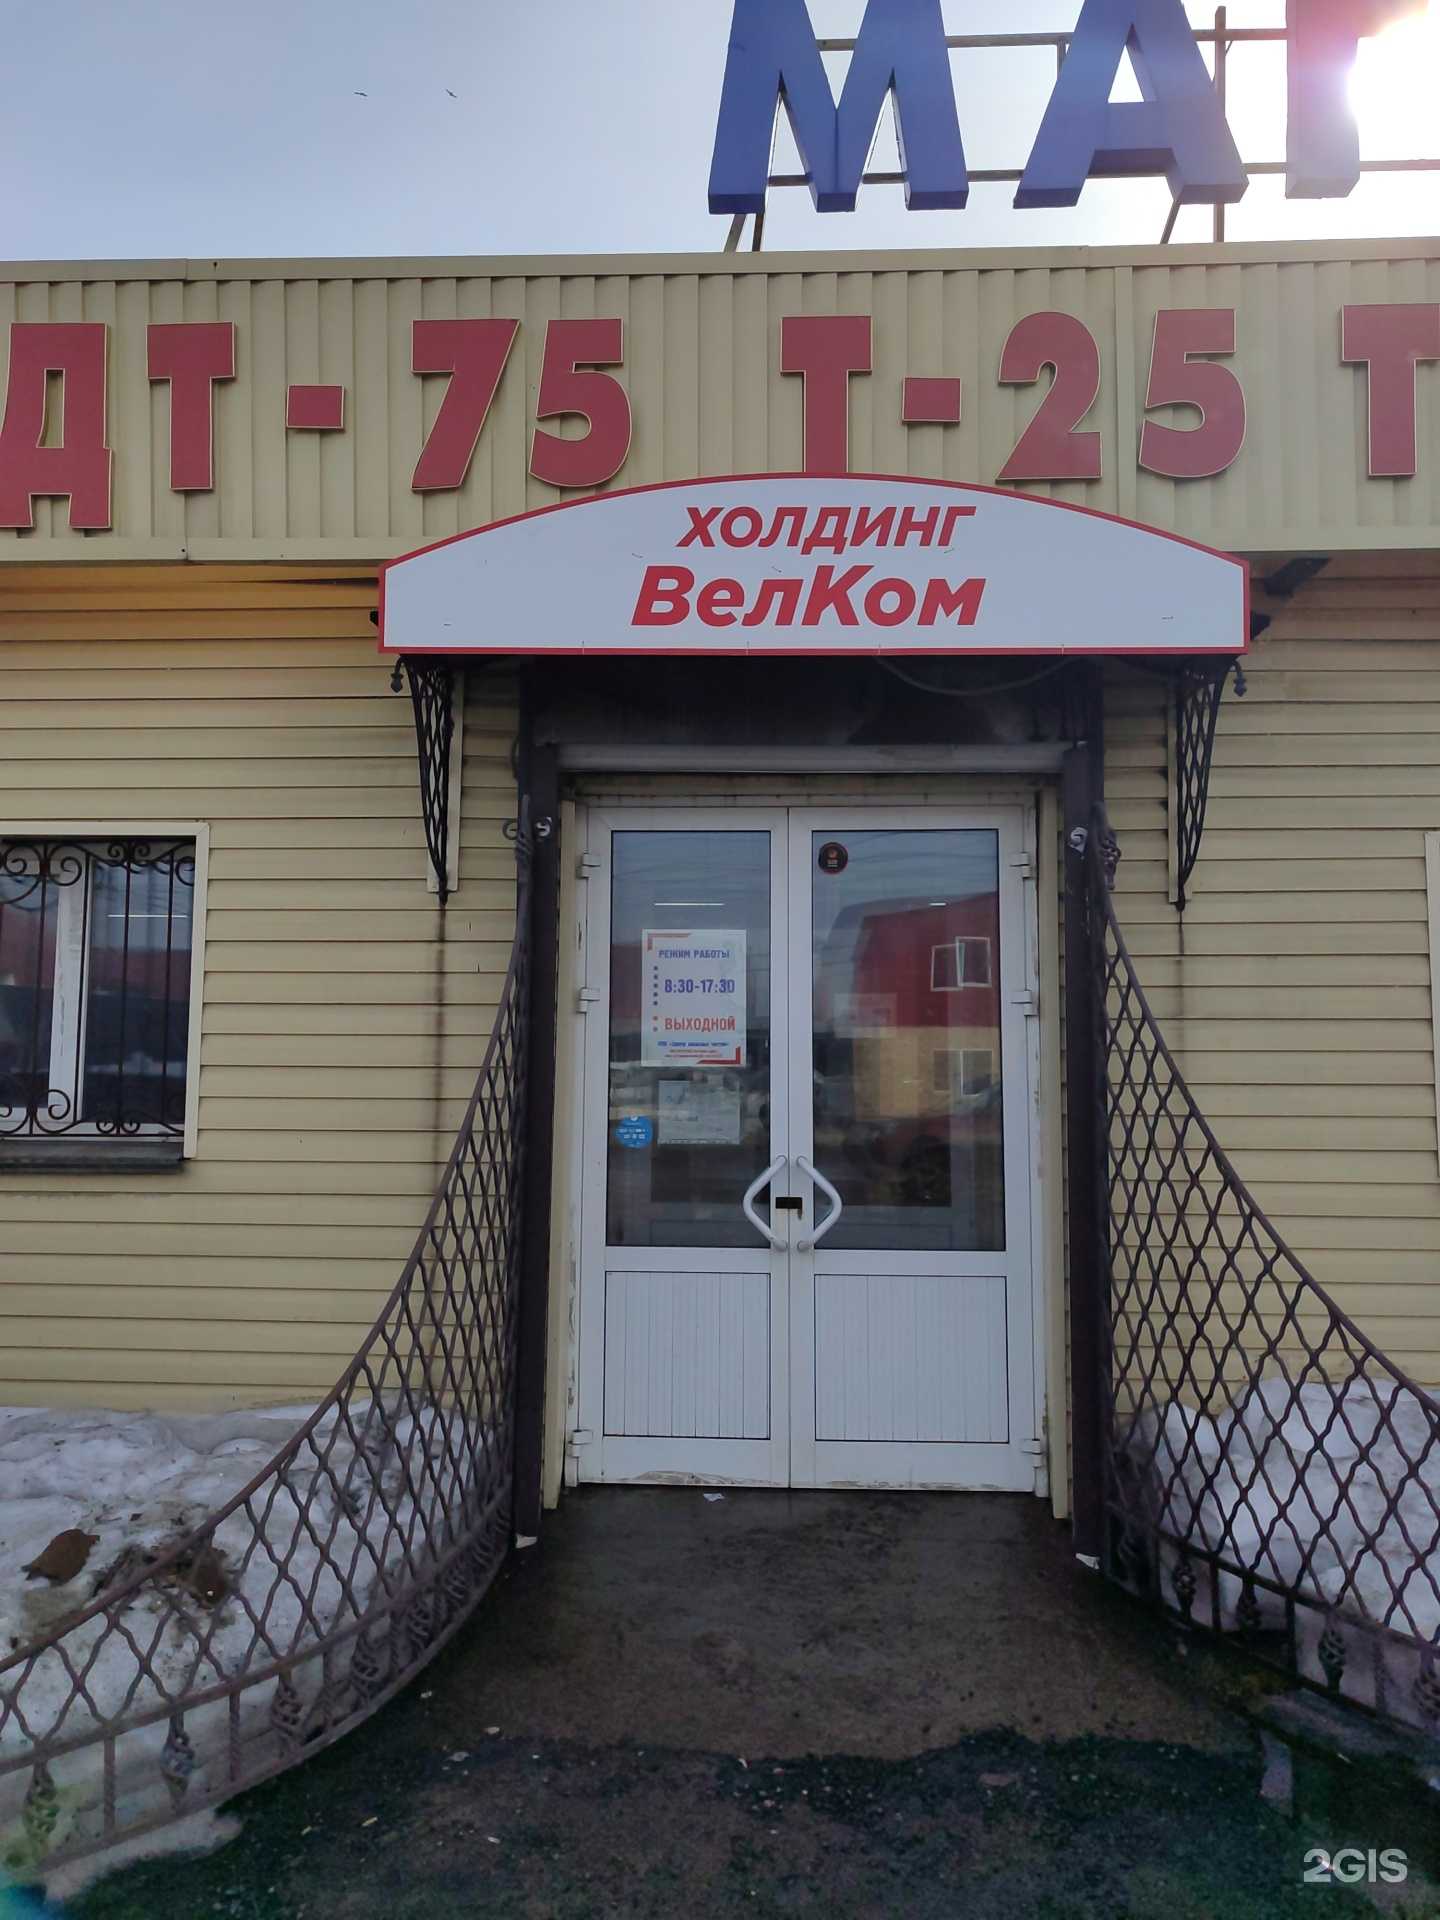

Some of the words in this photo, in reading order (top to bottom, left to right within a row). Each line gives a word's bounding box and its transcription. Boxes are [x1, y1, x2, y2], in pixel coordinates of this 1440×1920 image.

[675, 506, 976, 555] ХОЛДИНГ
[631, 564, 986, 627] ВелКом
[658, 949, 691, 959] РЕЖИМ
[693, 949, 730, 959] РАБОТЫ
[664, 979, 735, 993] 8:30-17:30
[664, 1015, 736, 1032] ВЫХОДНОЙ
